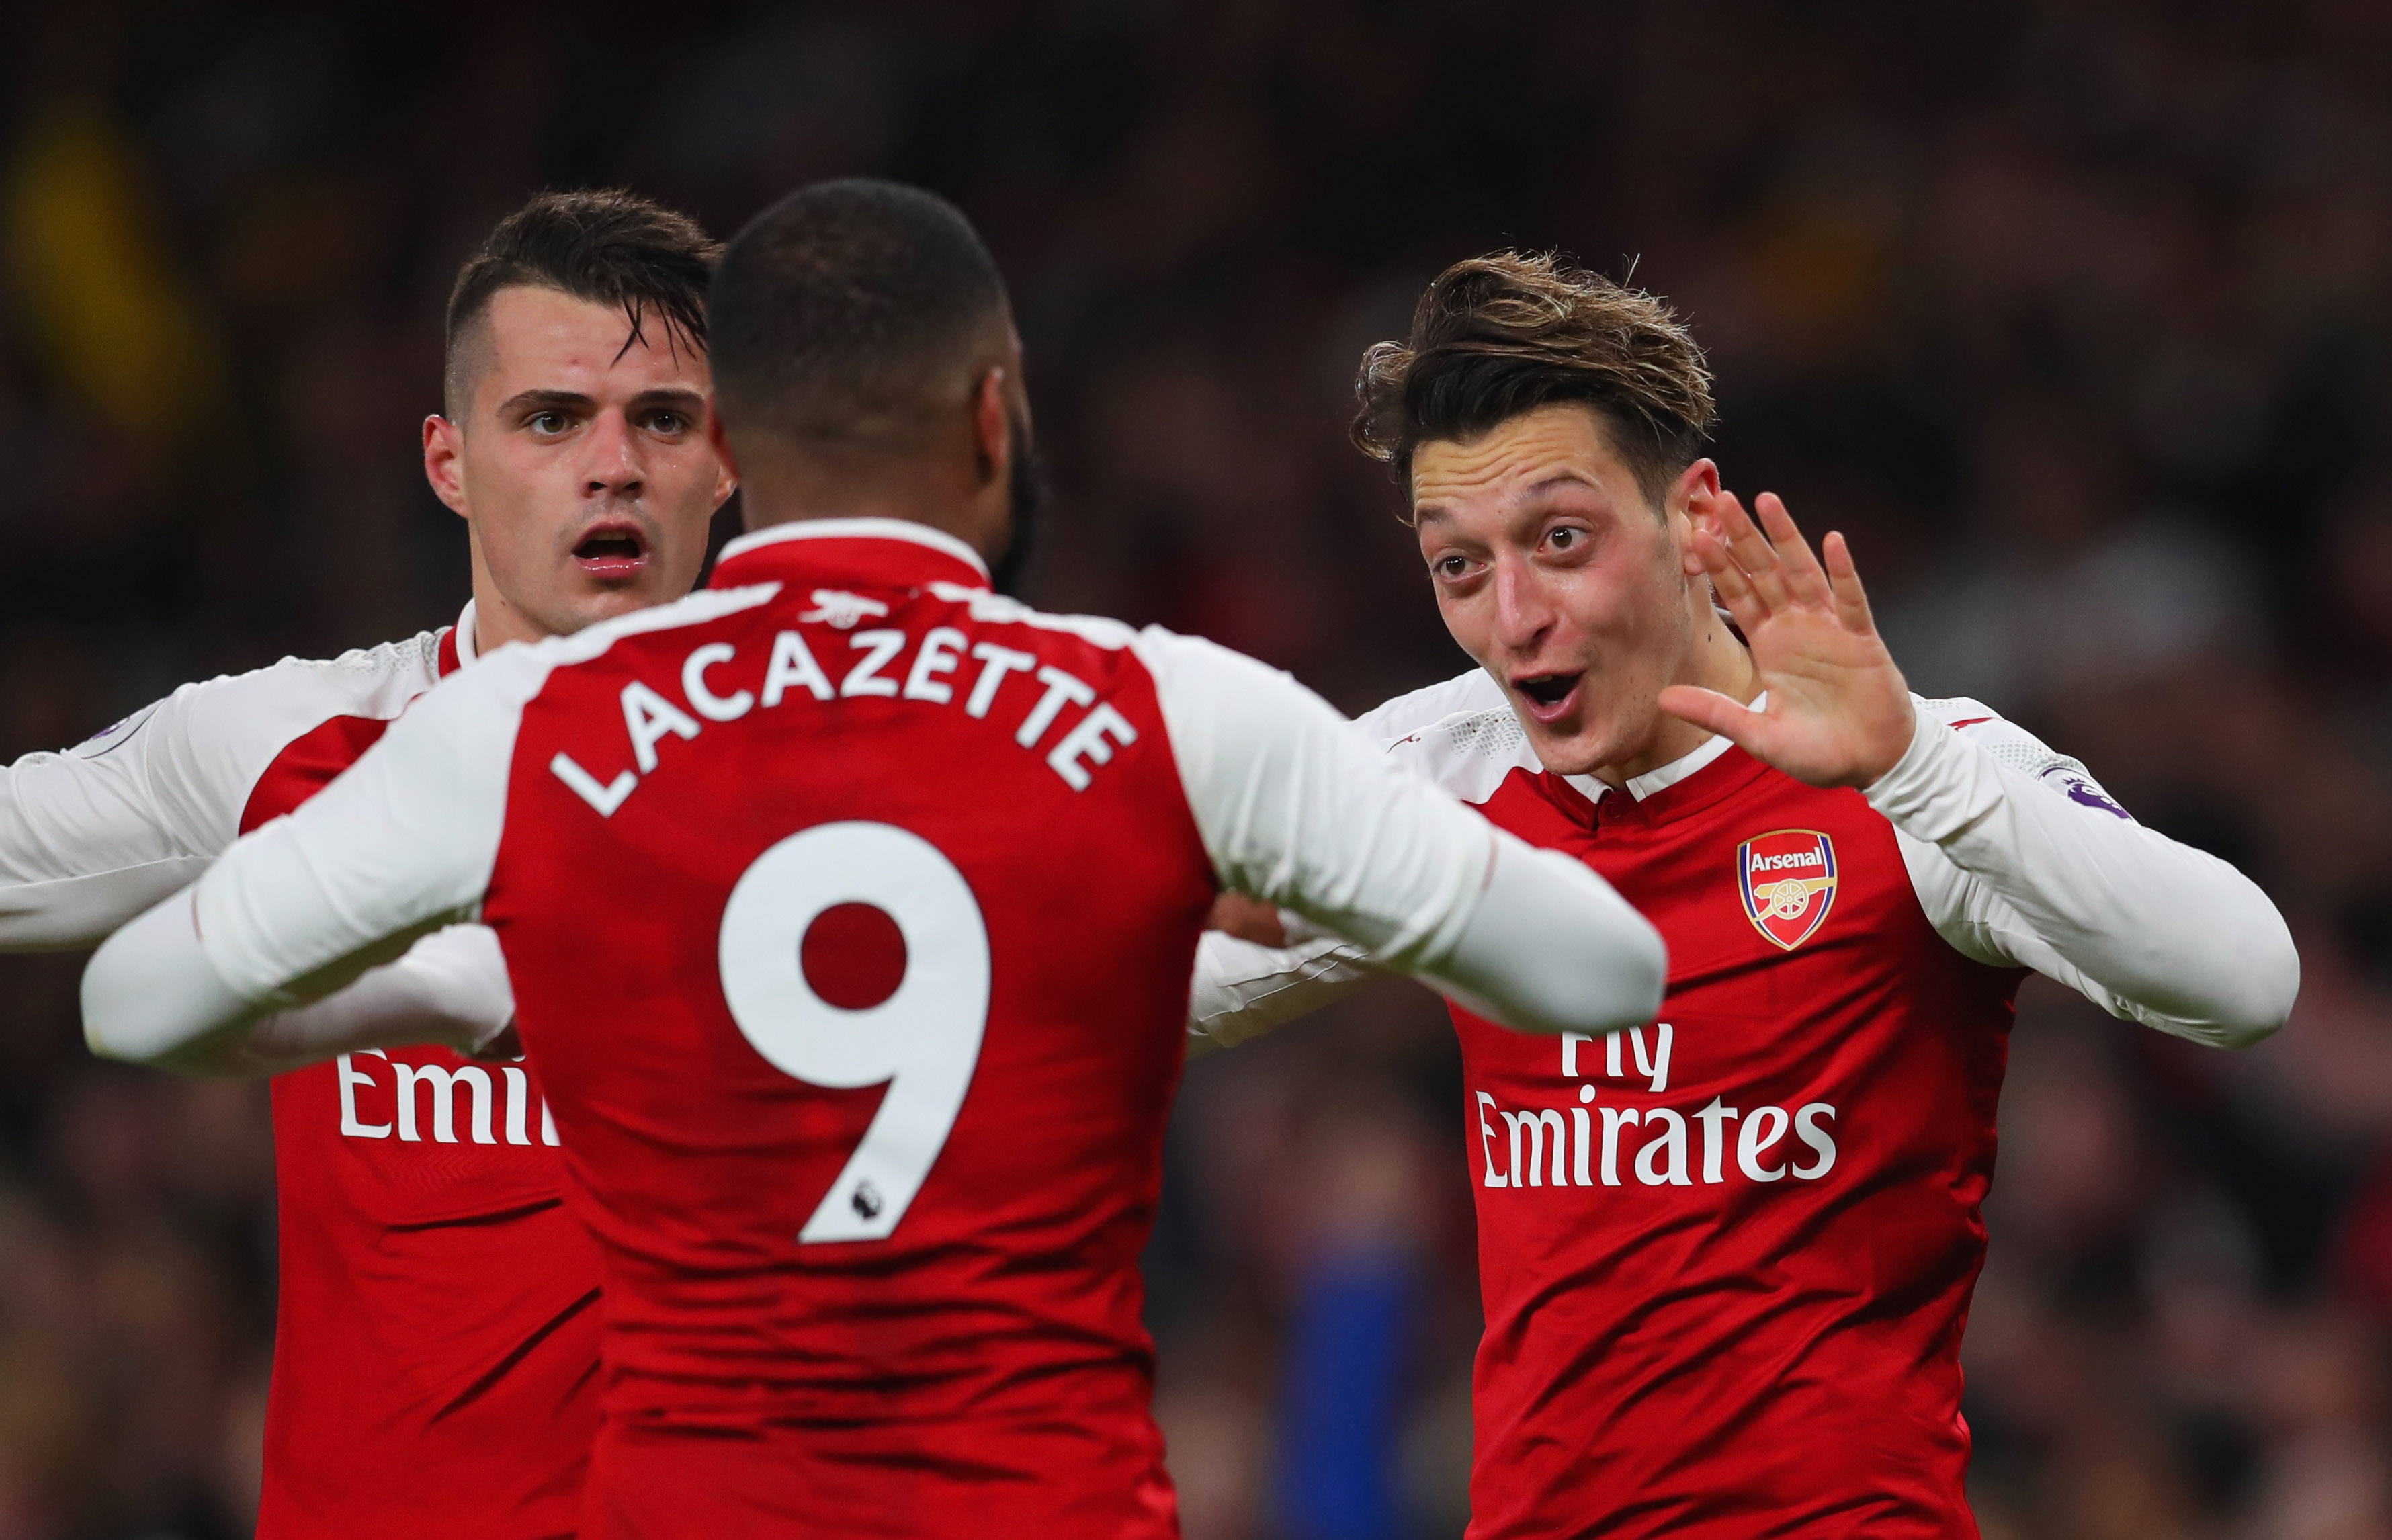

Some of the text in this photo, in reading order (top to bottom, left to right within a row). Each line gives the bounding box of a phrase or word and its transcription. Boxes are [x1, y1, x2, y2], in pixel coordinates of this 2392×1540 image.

[550, 627, 1137, 817] LACAZETTE
[1750, 847, 1823, 872] Arsenal
[718, 820, 991, 1244] 9
[1476, 1084, 1836, 1188] Emirates
